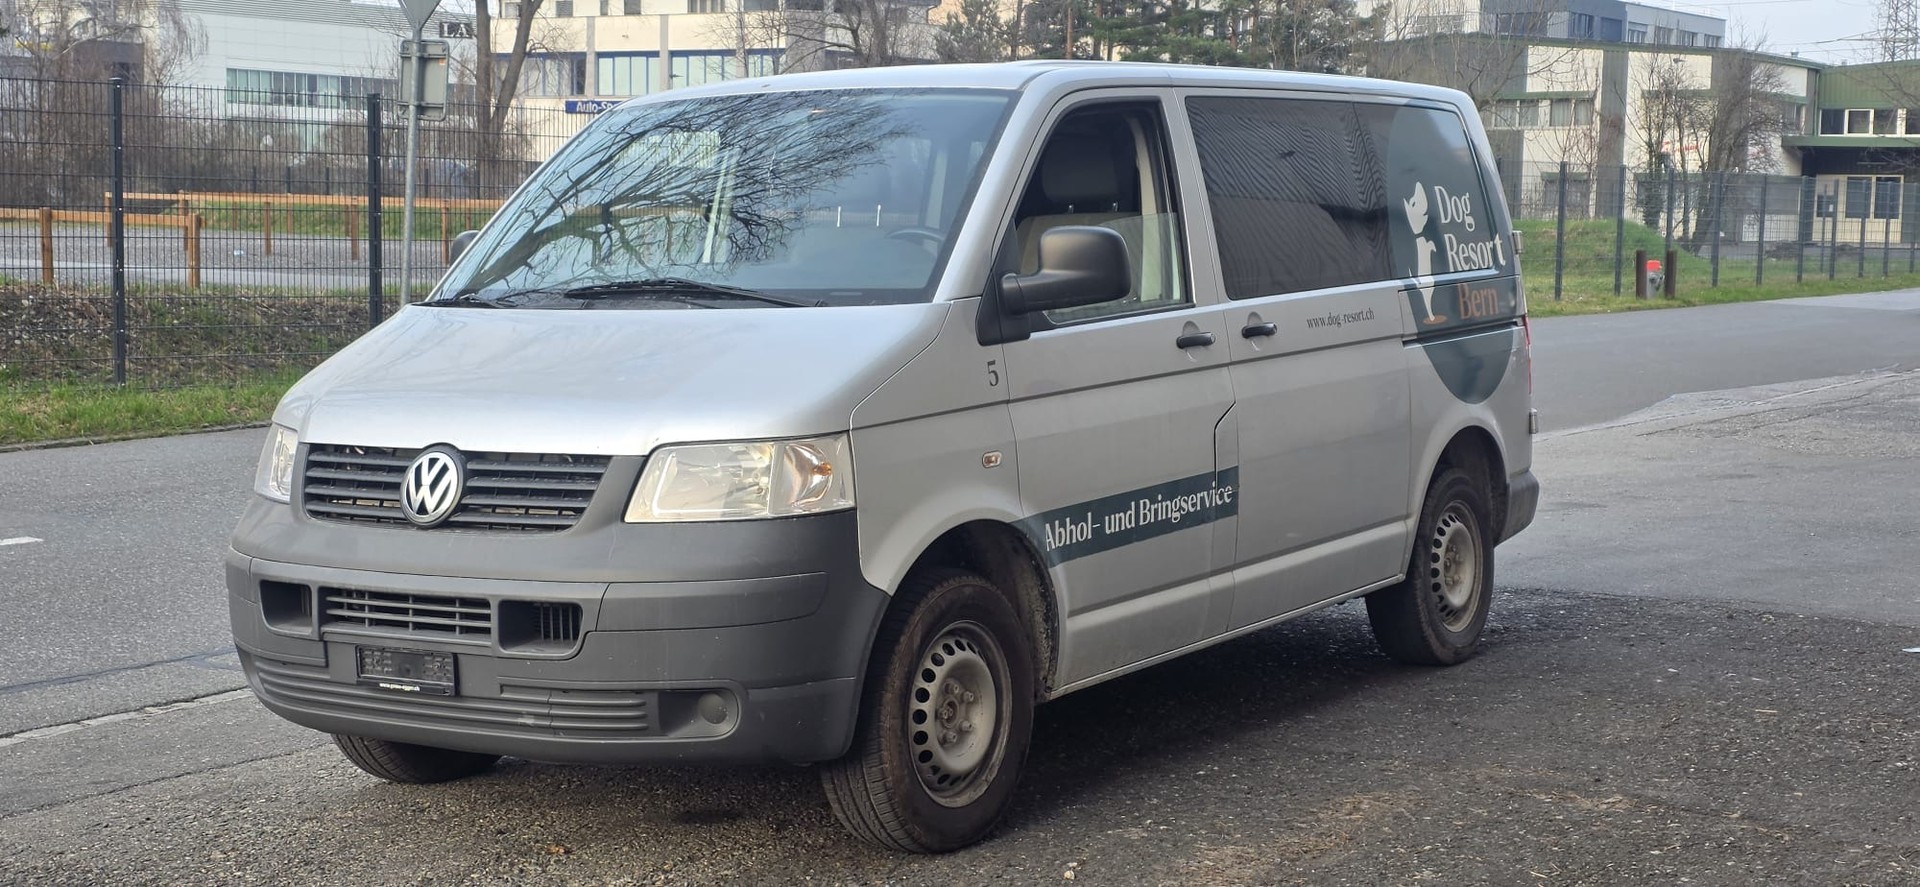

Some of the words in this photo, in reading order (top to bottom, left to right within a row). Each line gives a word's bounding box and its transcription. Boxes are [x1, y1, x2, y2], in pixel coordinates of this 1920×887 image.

[1434, 185, 1476, 232] Dog
[1443, 232, 1506, 272] Resort
[1306, 307, 1375, 329] www.dog-resort.ch
[1457, 283, 1499, 320] Bern
[987, 359, 999, 387] 5
[1044, 512, 1101, 552] Abhol-
[1105, 502, 1136, 535] und
[1139, 481, 1233, 526] Bringservice
